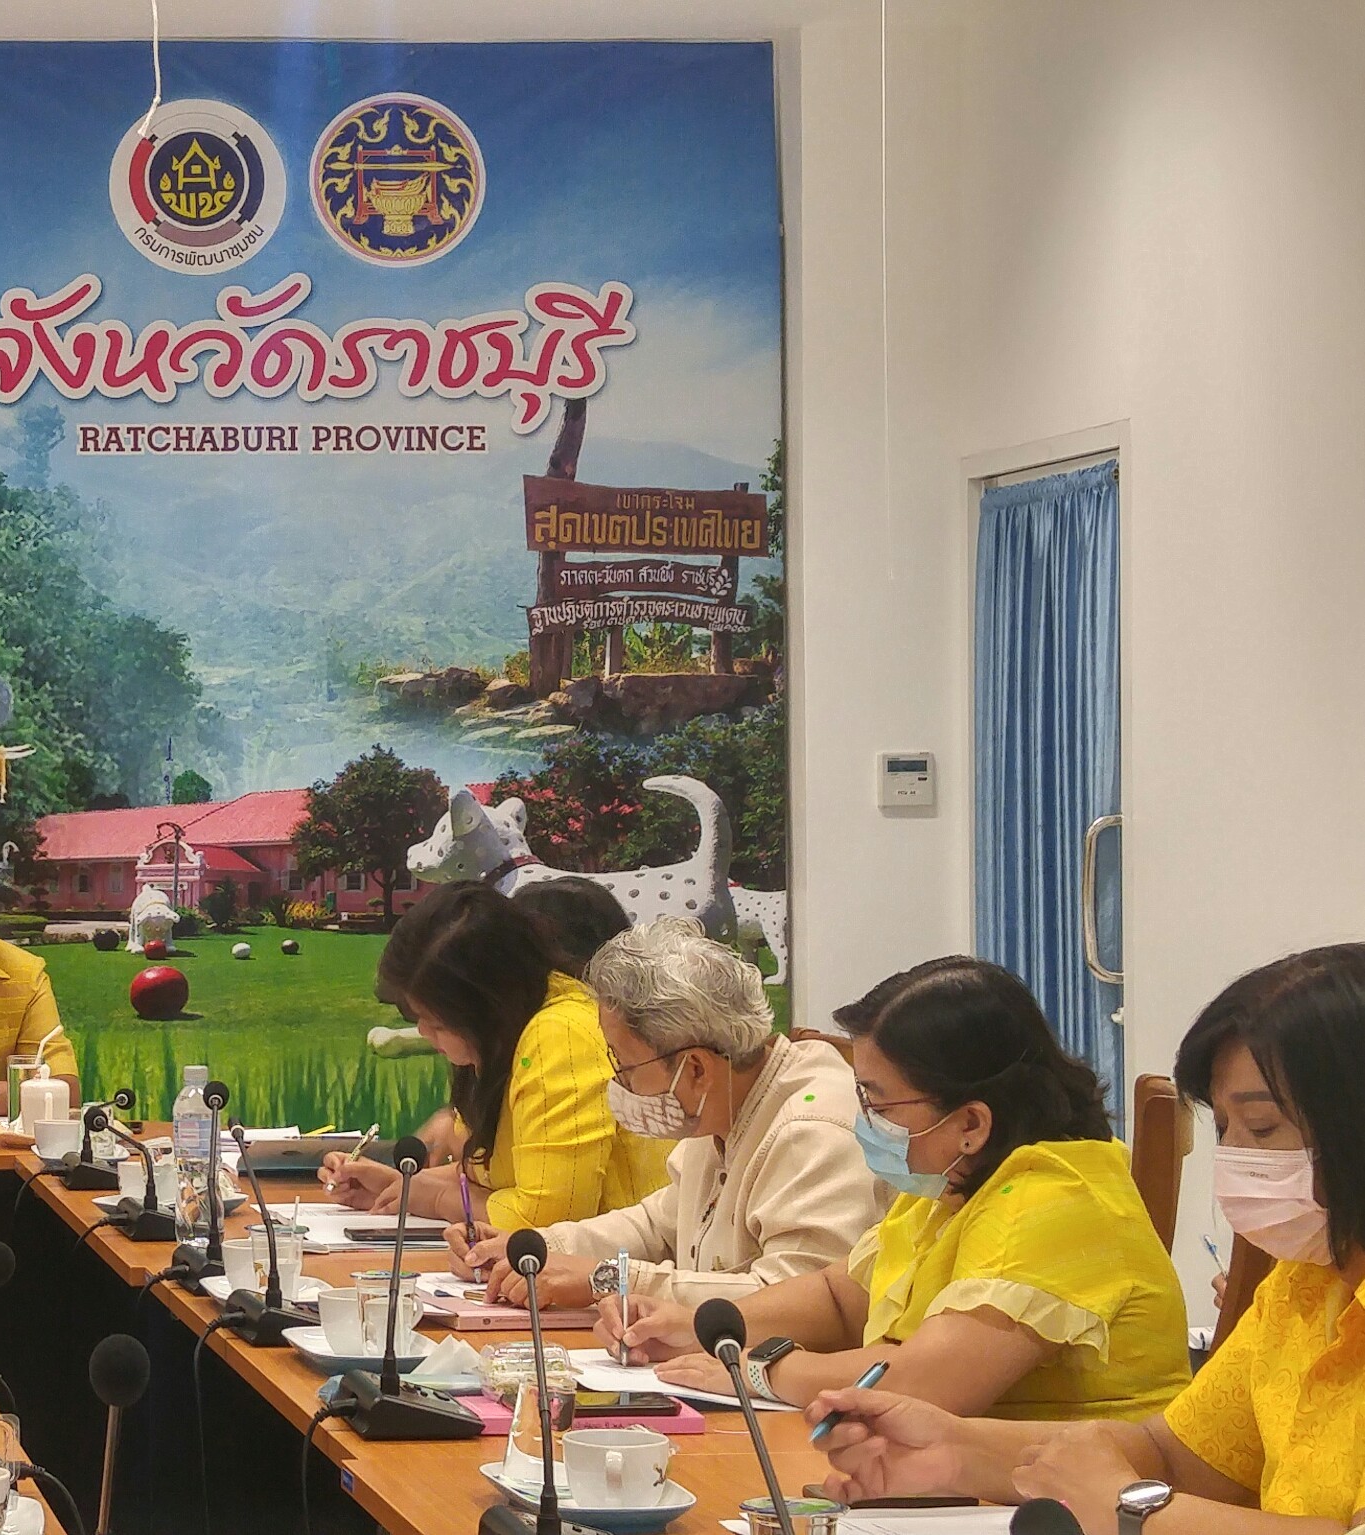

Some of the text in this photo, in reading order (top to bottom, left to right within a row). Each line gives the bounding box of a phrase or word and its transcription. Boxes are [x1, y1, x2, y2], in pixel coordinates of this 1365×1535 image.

[134, 224, 266, 267] กรมการพัฒนาชุมชน
[79, 424, 487, 454] RATCHABURI PROVINCE
[616, 490, 696, 511] เขากระโจม
[534, 504, 761, 550] สุดเขตประเทศไทย
[560, 563, 635, 586] ภาคตะวันตก
